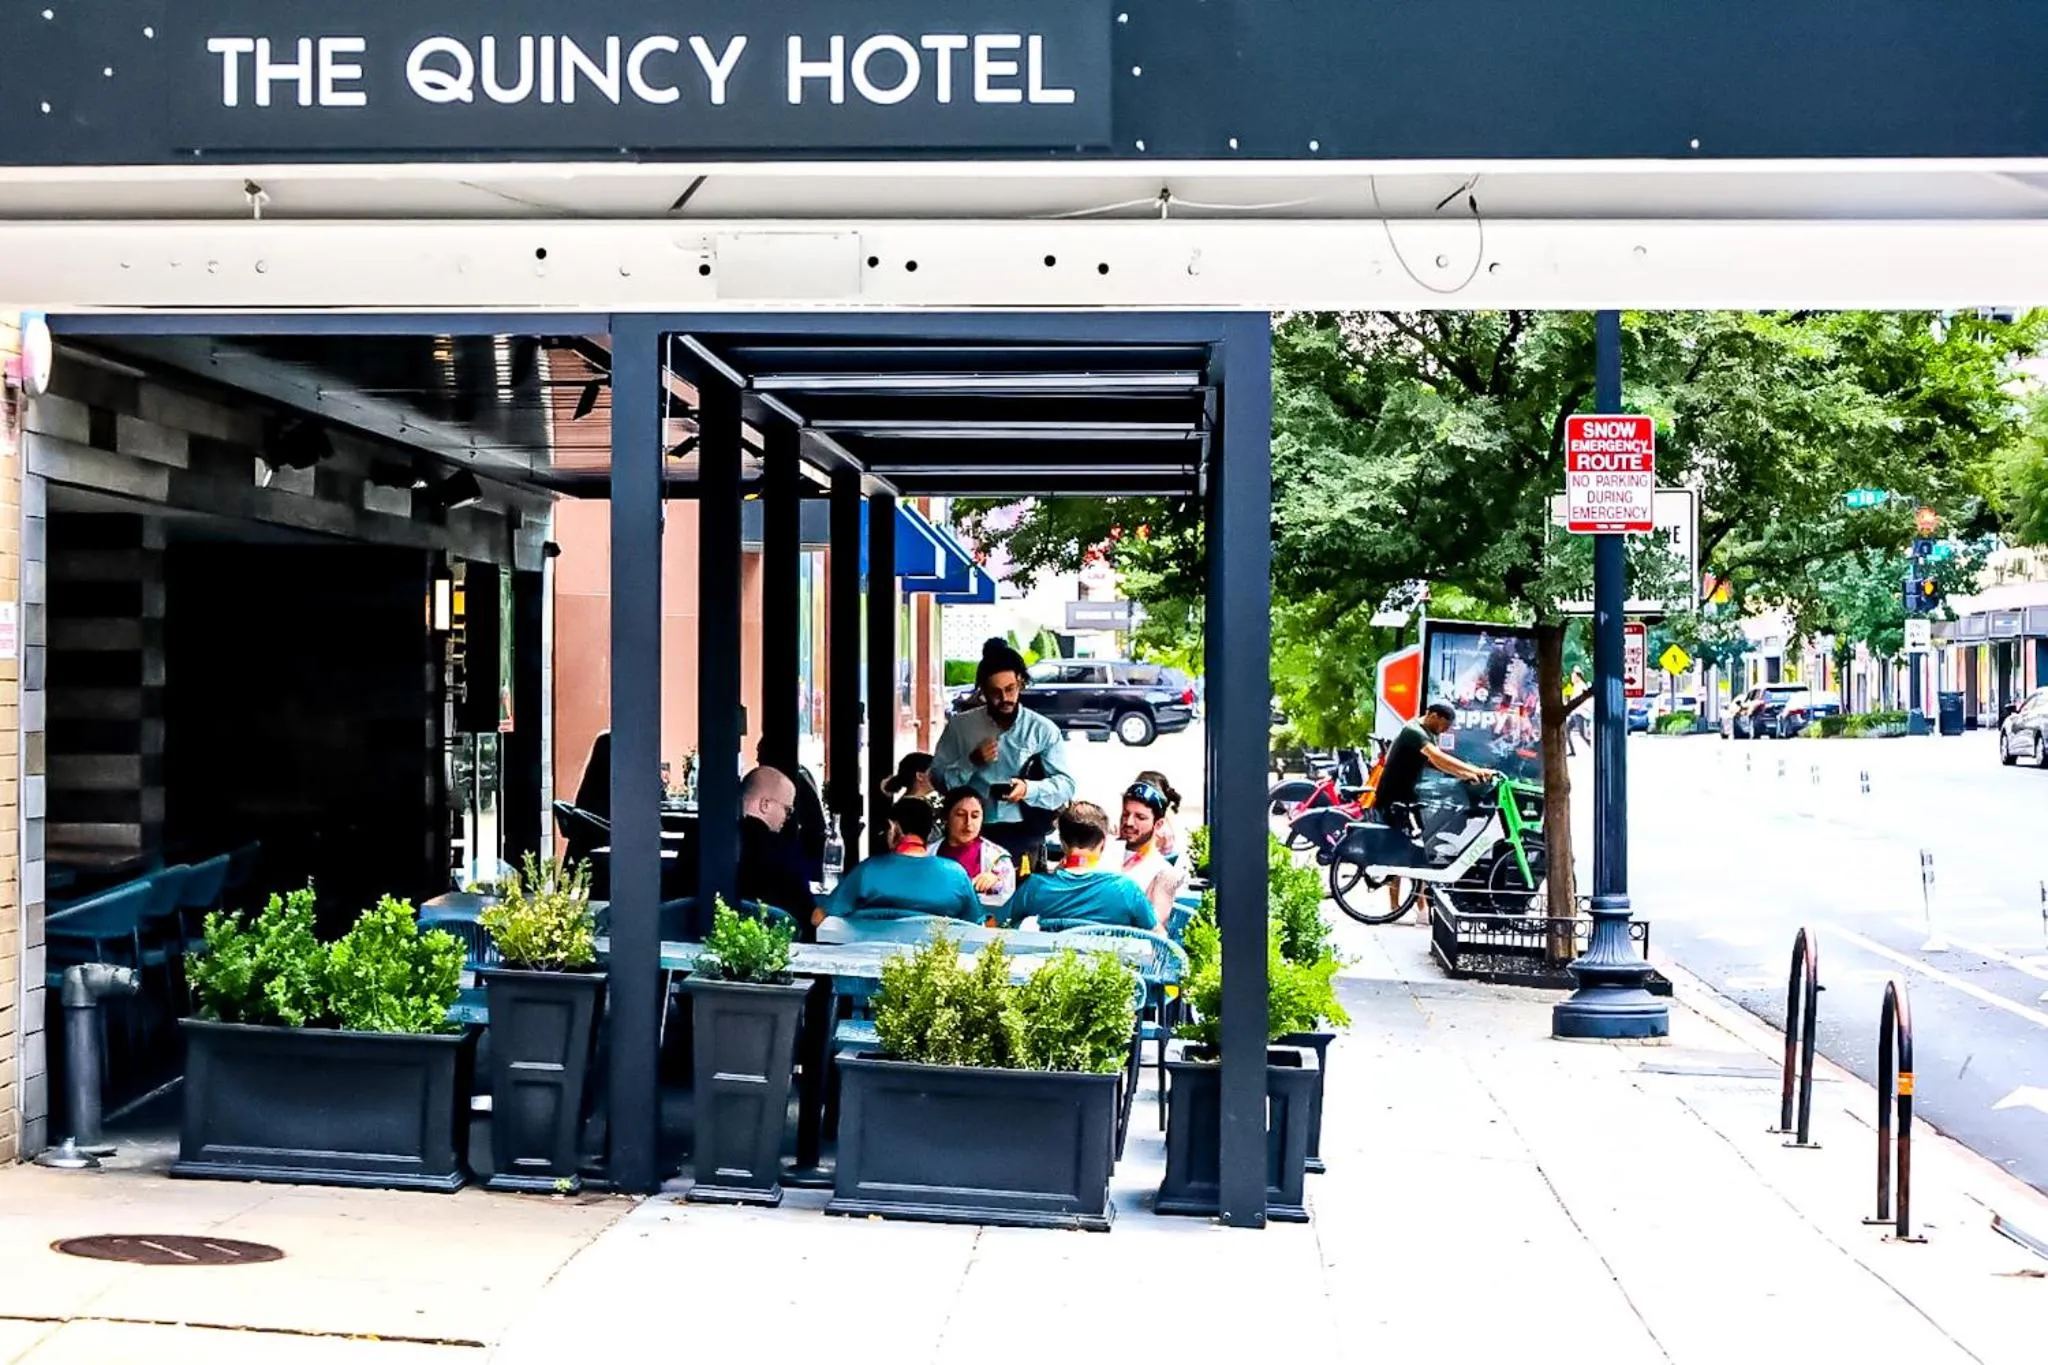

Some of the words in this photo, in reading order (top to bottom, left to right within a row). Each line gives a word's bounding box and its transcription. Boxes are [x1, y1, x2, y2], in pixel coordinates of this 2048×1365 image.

[206, 36, 368, 107] THE
[406, 34, 748, 105] QUINCY
[787, 33, 1076, 105] HOTEL
[1583, 421, 1636, 438] SNOW
[1571, 439, 1648, 453] EMERGENCY
[1577, 453, 1642, 470] ROUTE
[1572, 475, 1590, 488] NO
[1596, 475, 1648, 488] PARKING
[1587, 490, 1633, 504] DURING
[1572, 506, 1648, 519] EMERGENCY
